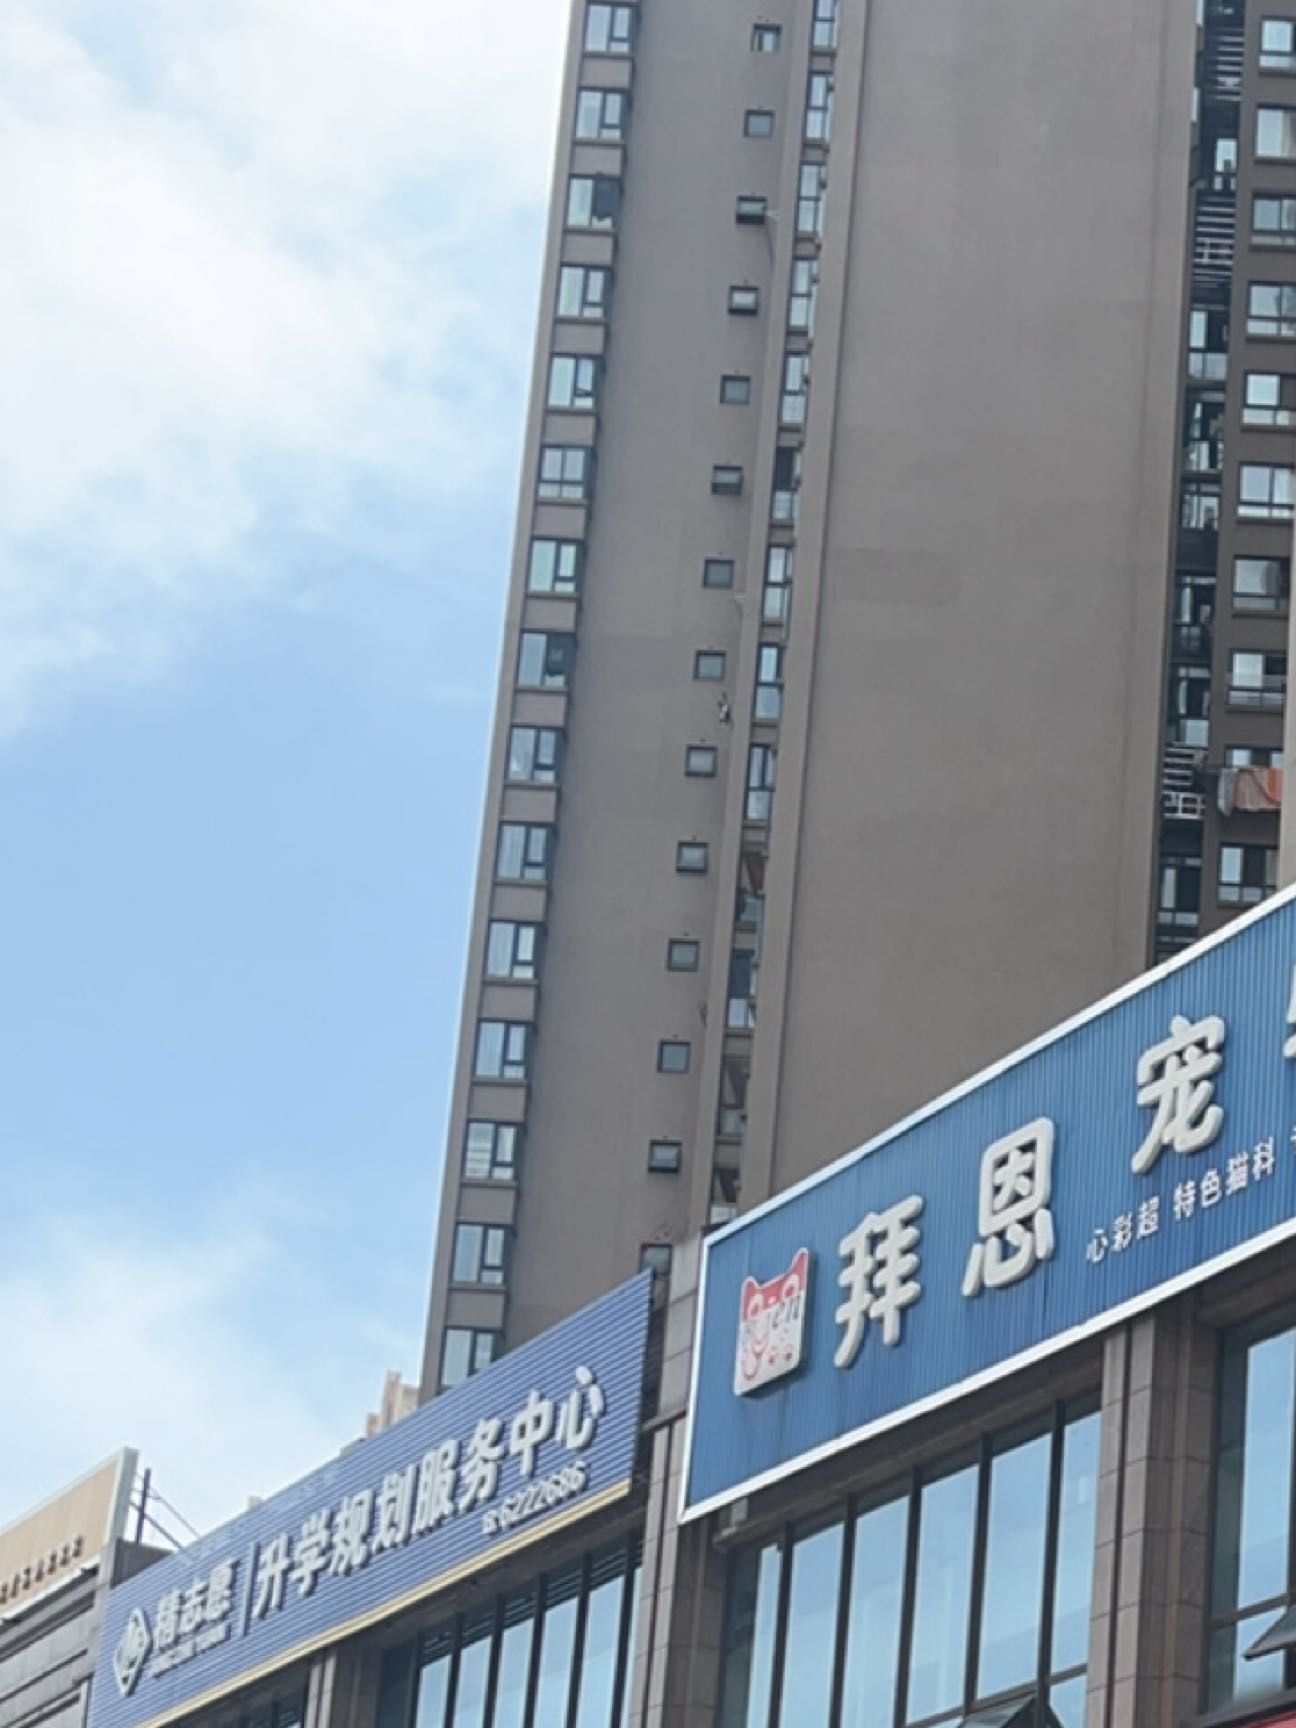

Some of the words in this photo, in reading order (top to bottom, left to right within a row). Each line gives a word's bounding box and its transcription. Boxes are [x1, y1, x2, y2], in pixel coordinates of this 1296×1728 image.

[1086, 1194, 1161, 1264] 心彩超
[1172, 1136, 1276, 1220] 特色猫科
[253, 1365, 607, 1617] 升学规划服务中心
